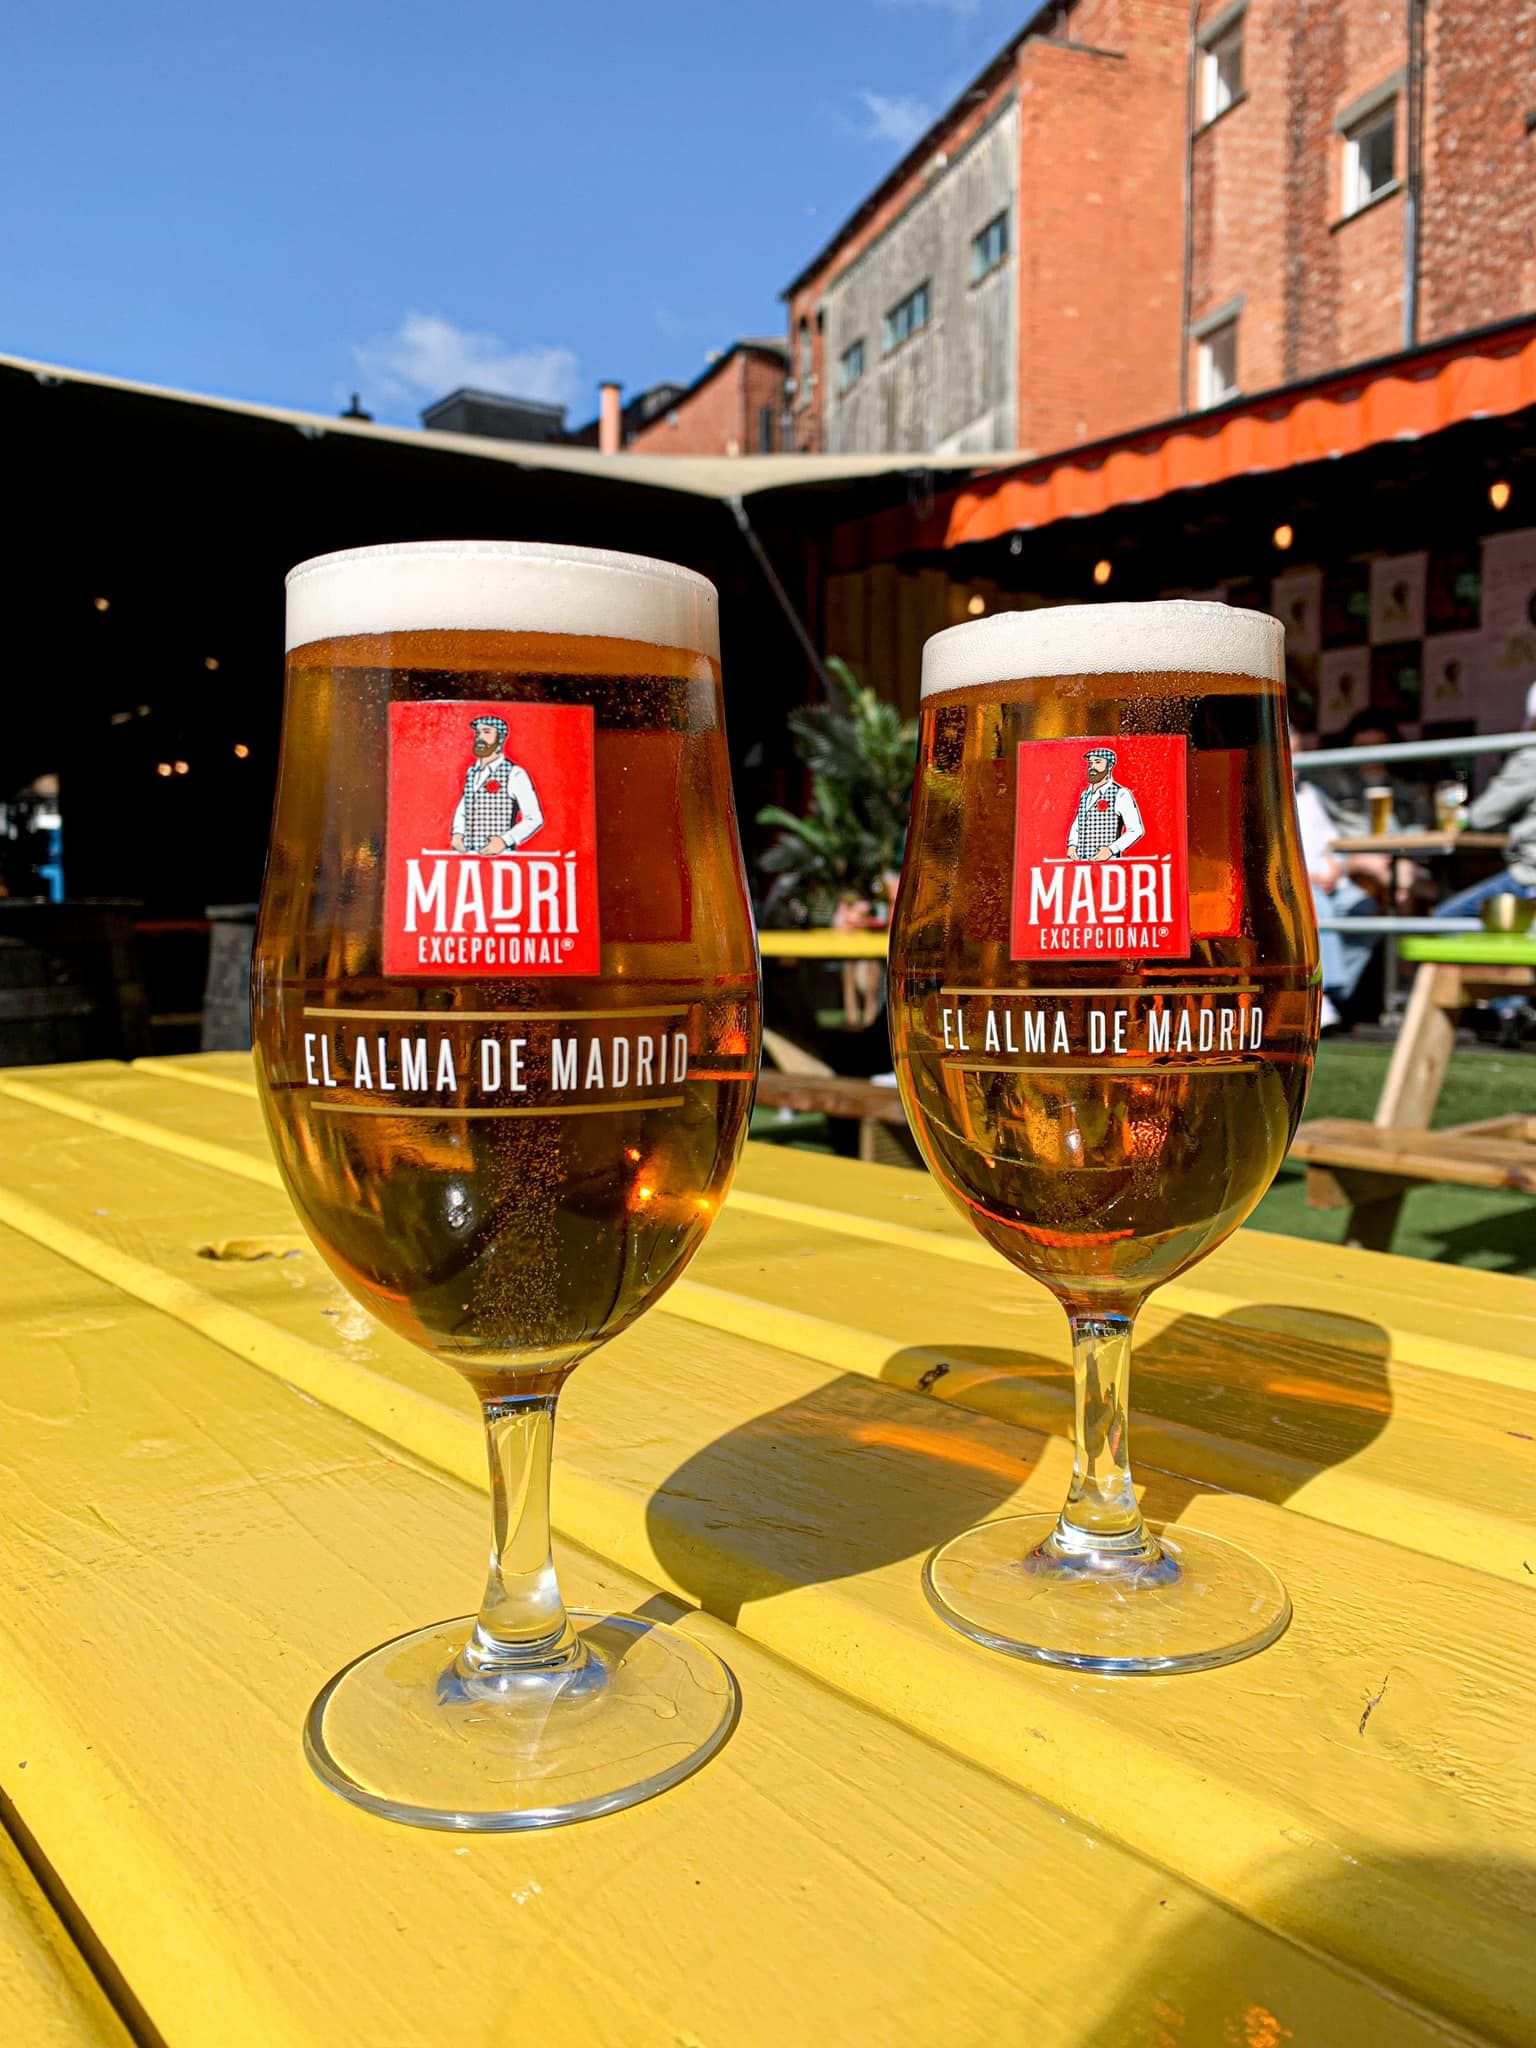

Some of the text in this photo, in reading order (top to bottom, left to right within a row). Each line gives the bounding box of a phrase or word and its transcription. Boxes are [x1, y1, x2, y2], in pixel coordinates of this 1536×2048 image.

[403, 850, 579, 934] MADRÍ
[1028, 854, 1174, 926] MADRÍ
[304, 1033, 689, 1092] EL ALMA DE MADRID
[942, 1006, 1264, 1054] EL ALMA DE MADRID
